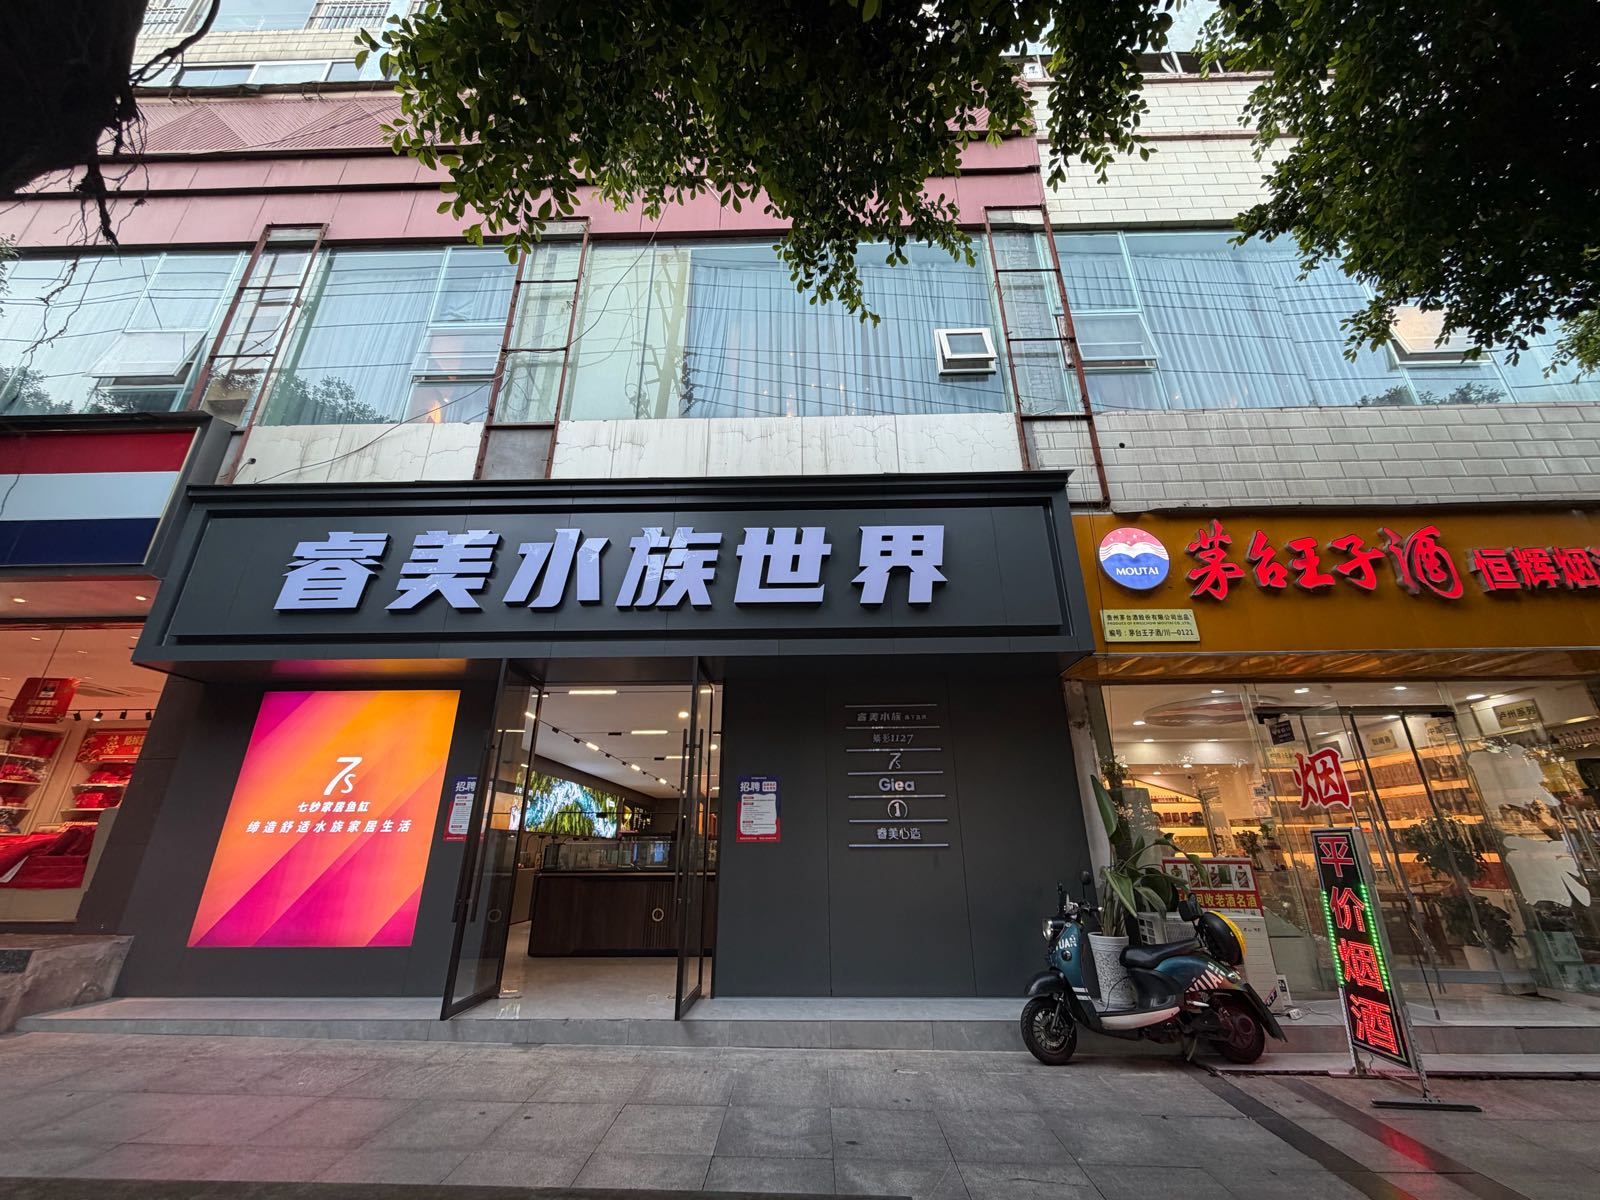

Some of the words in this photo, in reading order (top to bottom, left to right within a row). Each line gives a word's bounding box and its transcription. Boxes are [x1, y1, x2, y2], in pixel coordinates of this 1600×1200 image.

[1185, 519, 1464, 600] 茅台王子酒
[1474, 545, 1600, 592] 恒辉烟
[273, 525, 948, 611] 睿美水族世界
[1116, 566, 1159, 576] MOUTAI
[879, 778, 915, 791] Giea
[1293, 749, 1350, 810] 烟
[297, 801, 370, 813] 七秒家居鱼缸
[246, 820, 411, 833] 缔造舒适水族家居生活
[1179, 893, 1257, 908] 回收老酒名酒
[1317, 836, 1399, 1055] 平价烟酒
